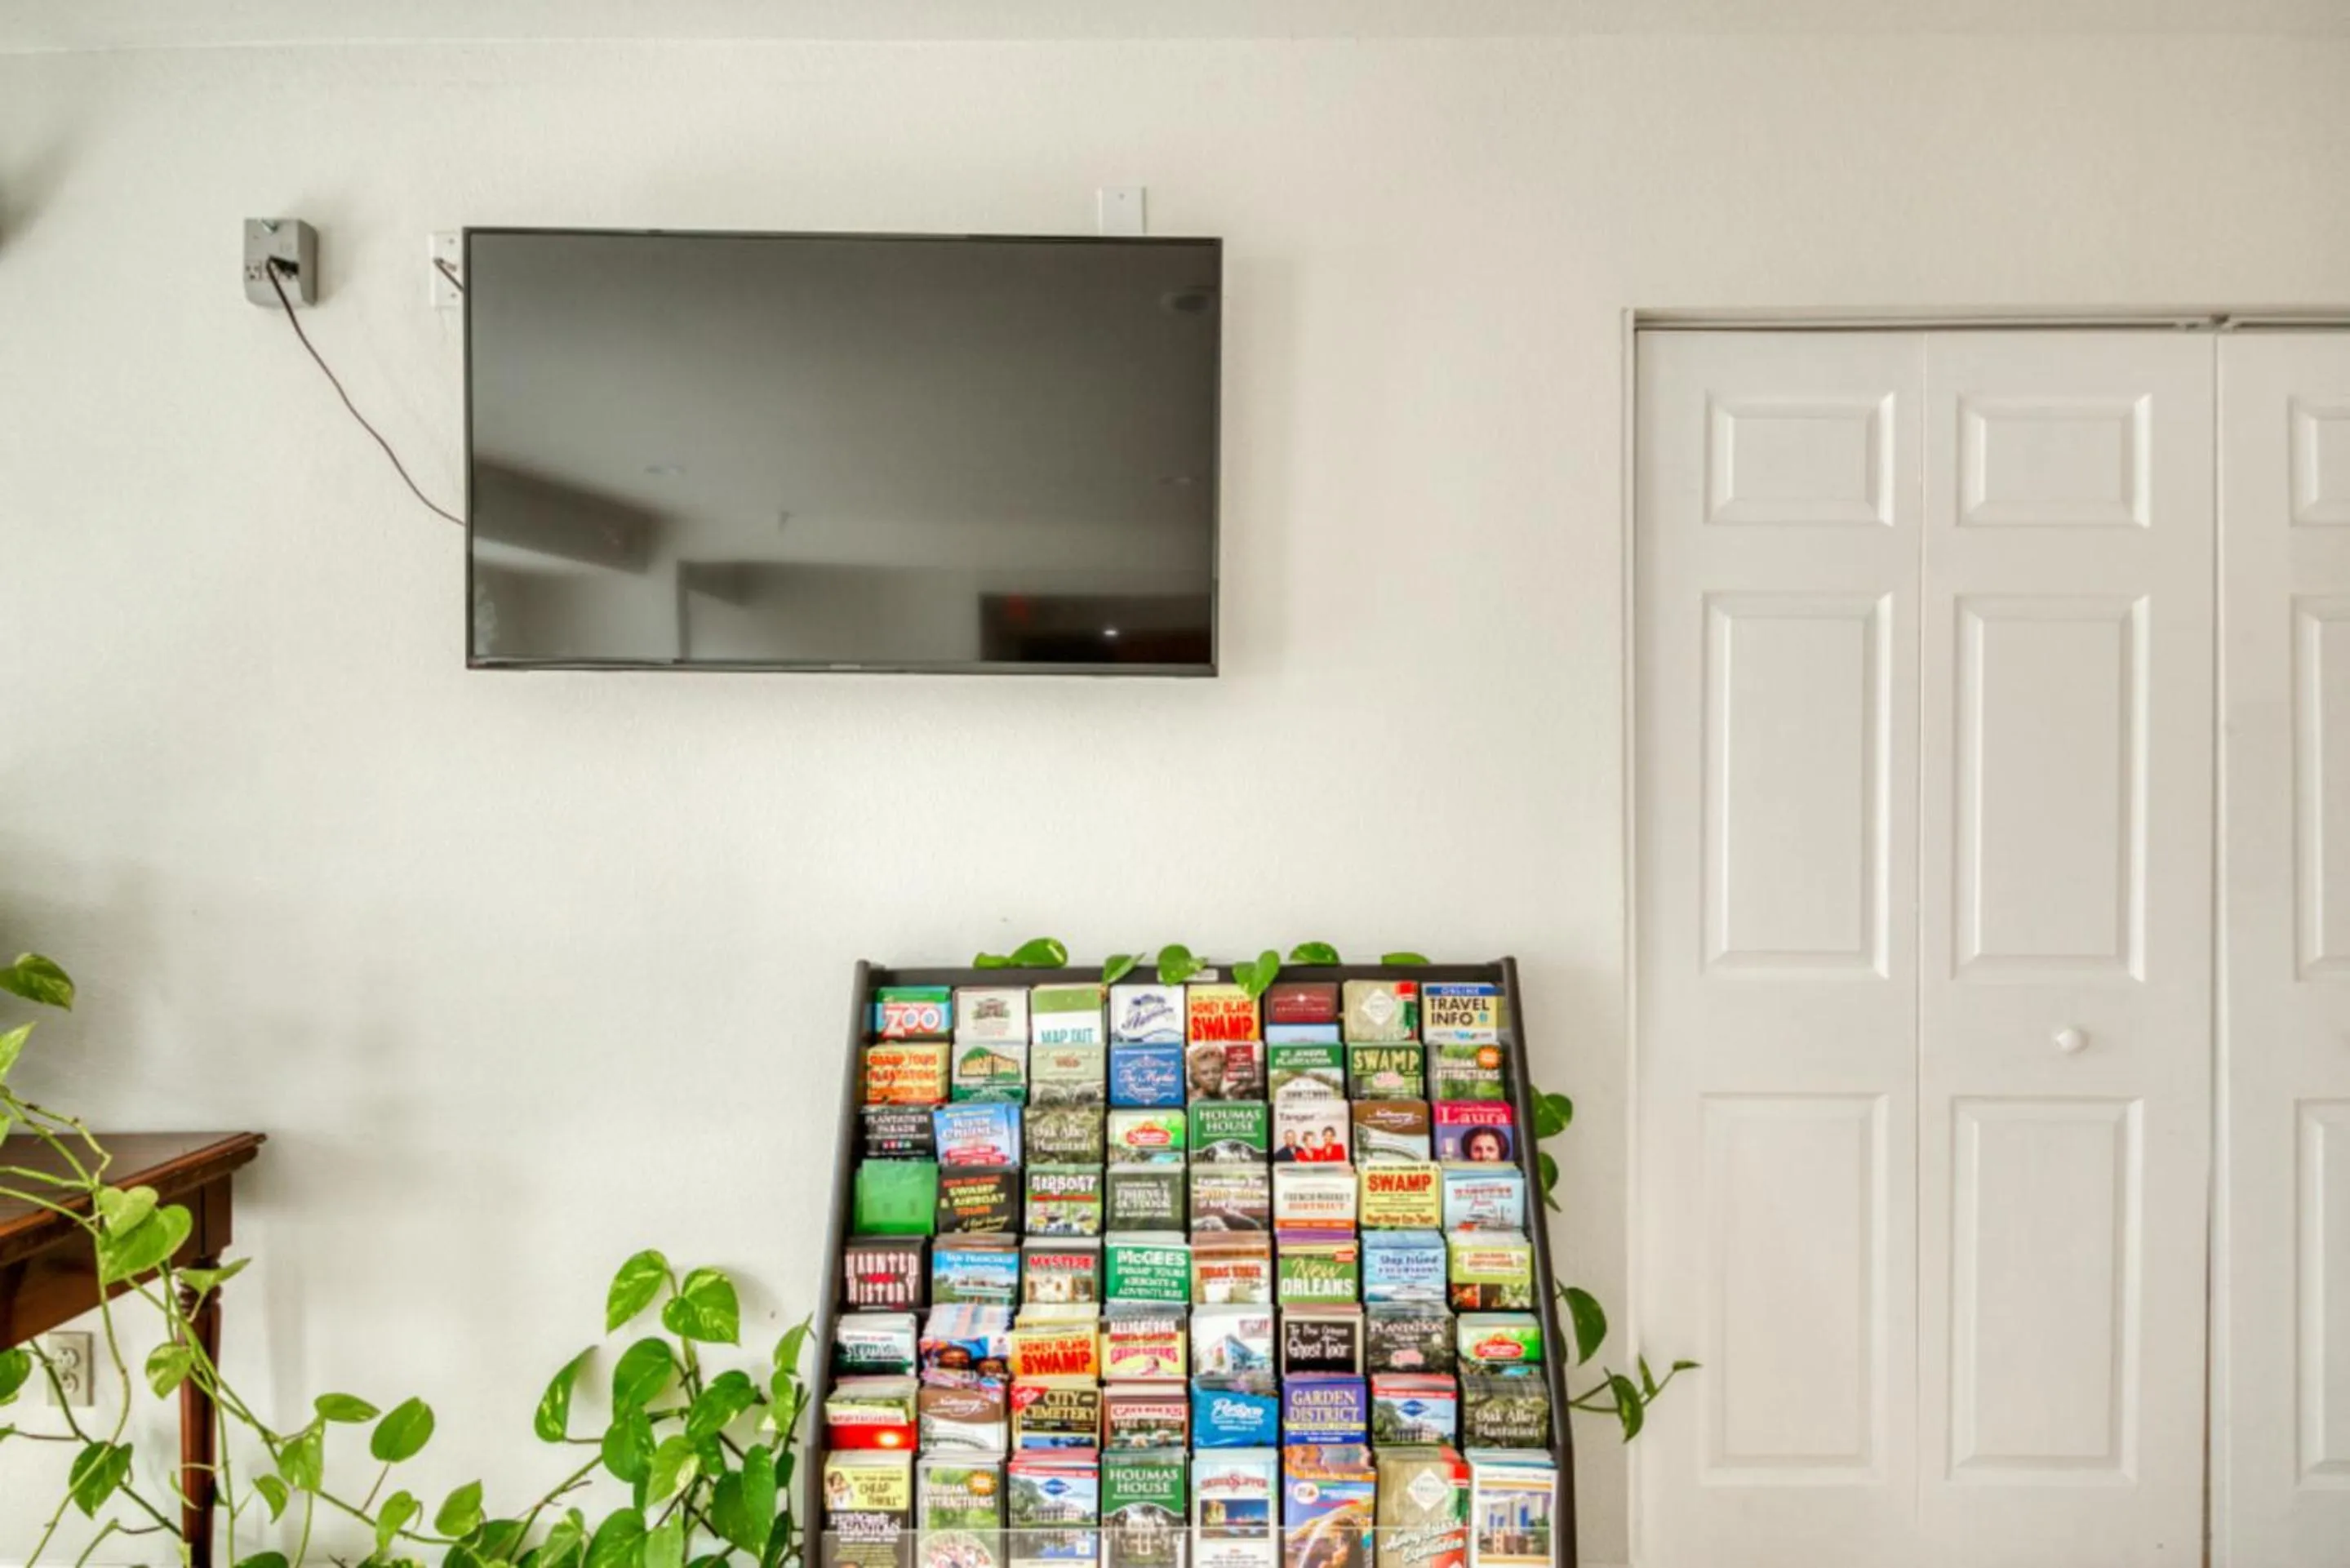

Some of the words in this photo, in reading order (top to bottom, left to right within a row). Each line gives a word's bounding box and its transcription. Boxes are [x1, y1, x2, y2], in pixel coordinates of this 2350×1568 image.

[1430, 997, 1490, 1011] TRAVEL
[884, 1006, 940, 1037] ZOO
[1431, 1012, 1473, 1026] INFO
[1190, 1016, 1254, 1042] SWAMP
[1353, 1050, 1420, 1069] SWAMP
[1199, 1109, 1262, 1121] HOUMAS
[1278, 1112, 1316, 1122] Tanger
[1441, 1106, 1509, 1125] Laura
[1206, 1121, 1255, 1132] HOUSE
[1367, 1174, 1433, 1193] SWAMP
[846, 1253, 917, 1277] HAUNTED
[1291, 1258, 1342, 1278] New
[847, 1274, 916, 1304] HISTORY
[1282, 1278, 1354, 1297] ORLEANS
[1021, 1352, 1092, 1375] SWAMP
[1044, 1391, 1079, 1406] CITY
[1291, 1390, 1357, 1406] GARDEN
[1289, 1406, 1361, 1422] DISTRICT
[1475, 1409, 1504, 1423] Oak
[1108, 1469, 1179, 1481] HOUMAS
[1116, 1482, 1171, 1494] HOUSE
